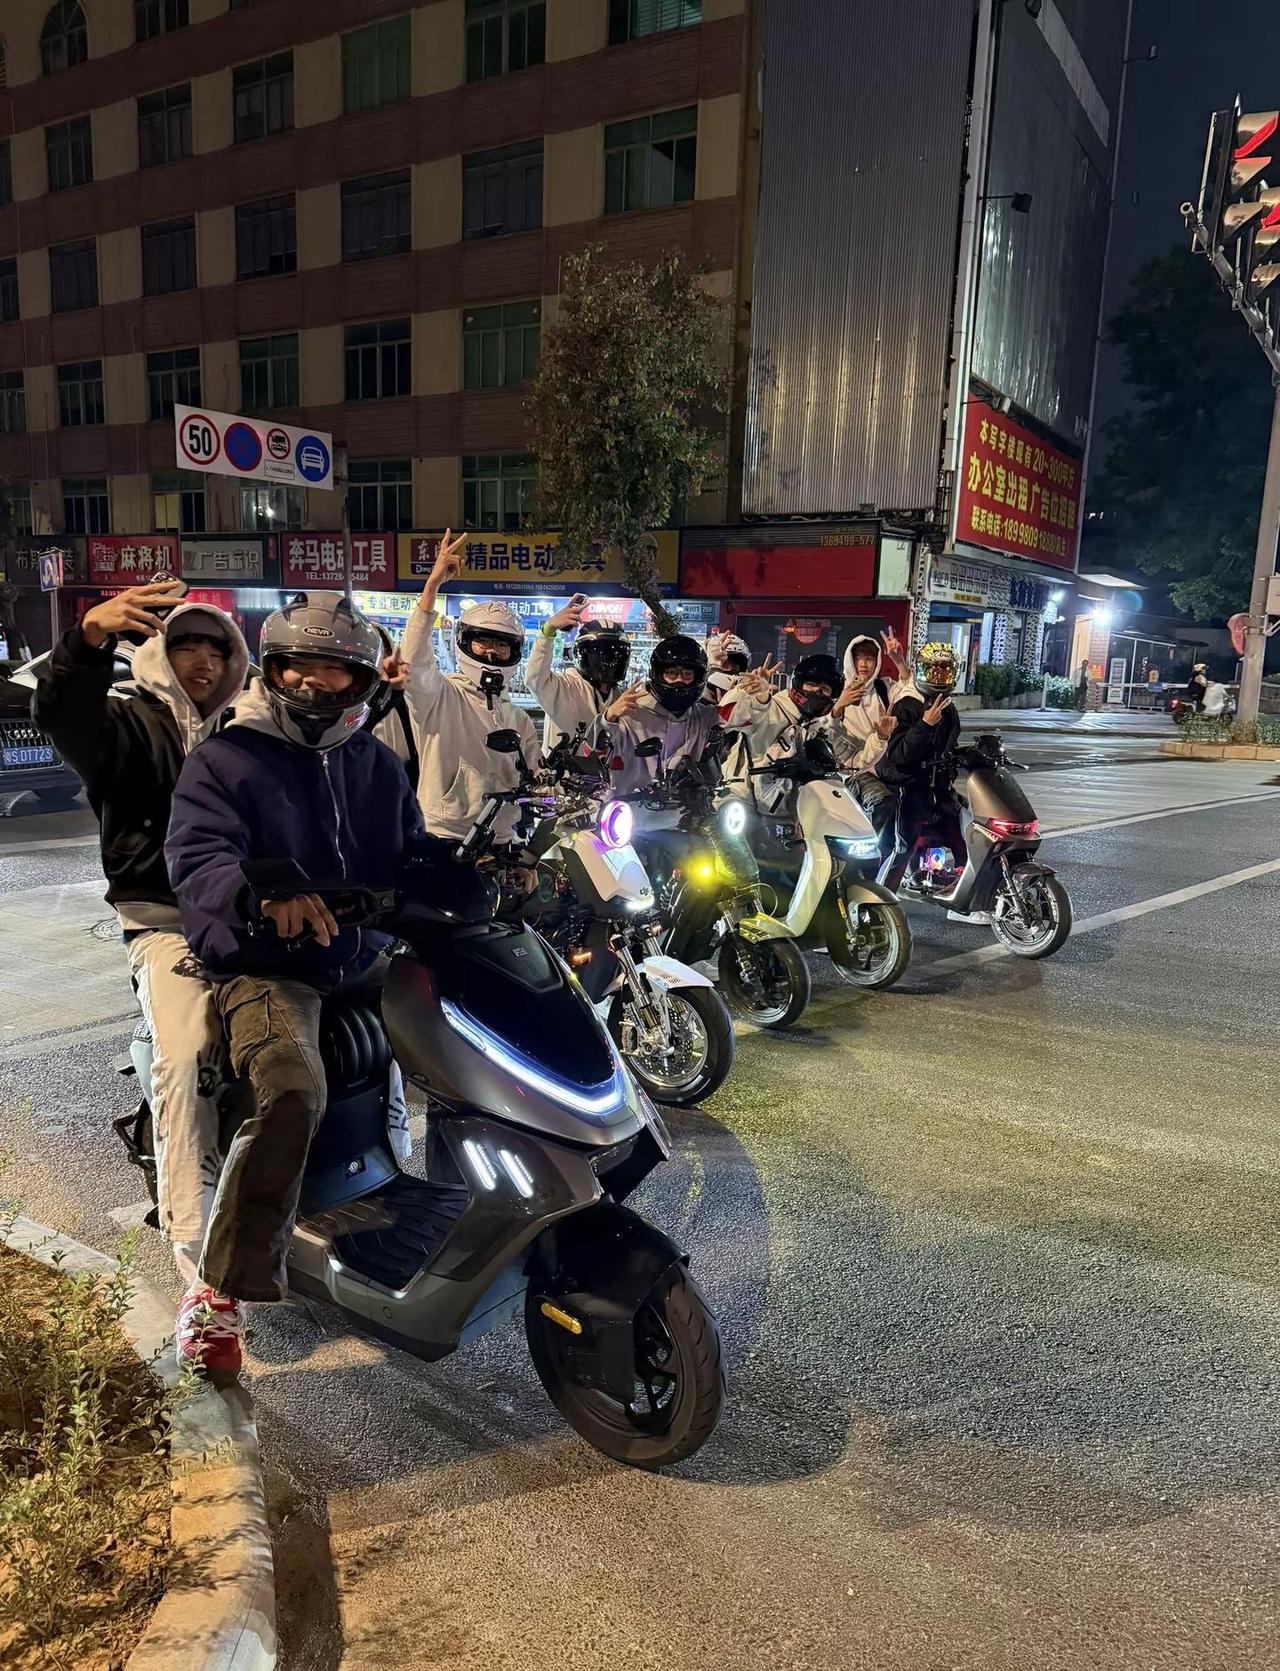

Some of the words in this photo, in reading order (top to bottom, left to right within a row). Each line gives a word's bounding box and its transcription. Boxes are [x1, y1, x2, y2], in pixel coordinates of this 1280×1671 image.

[189, 424, 212, 456] 50
[121, 544, 173, 572] 麻将机
[465, 542, 606, 572] 精品电动具
[305, 571, 369, 581] TEL:137285484
[415, 564, 434, 574] Dong
[508, 601, 554, 616] 电动工具
